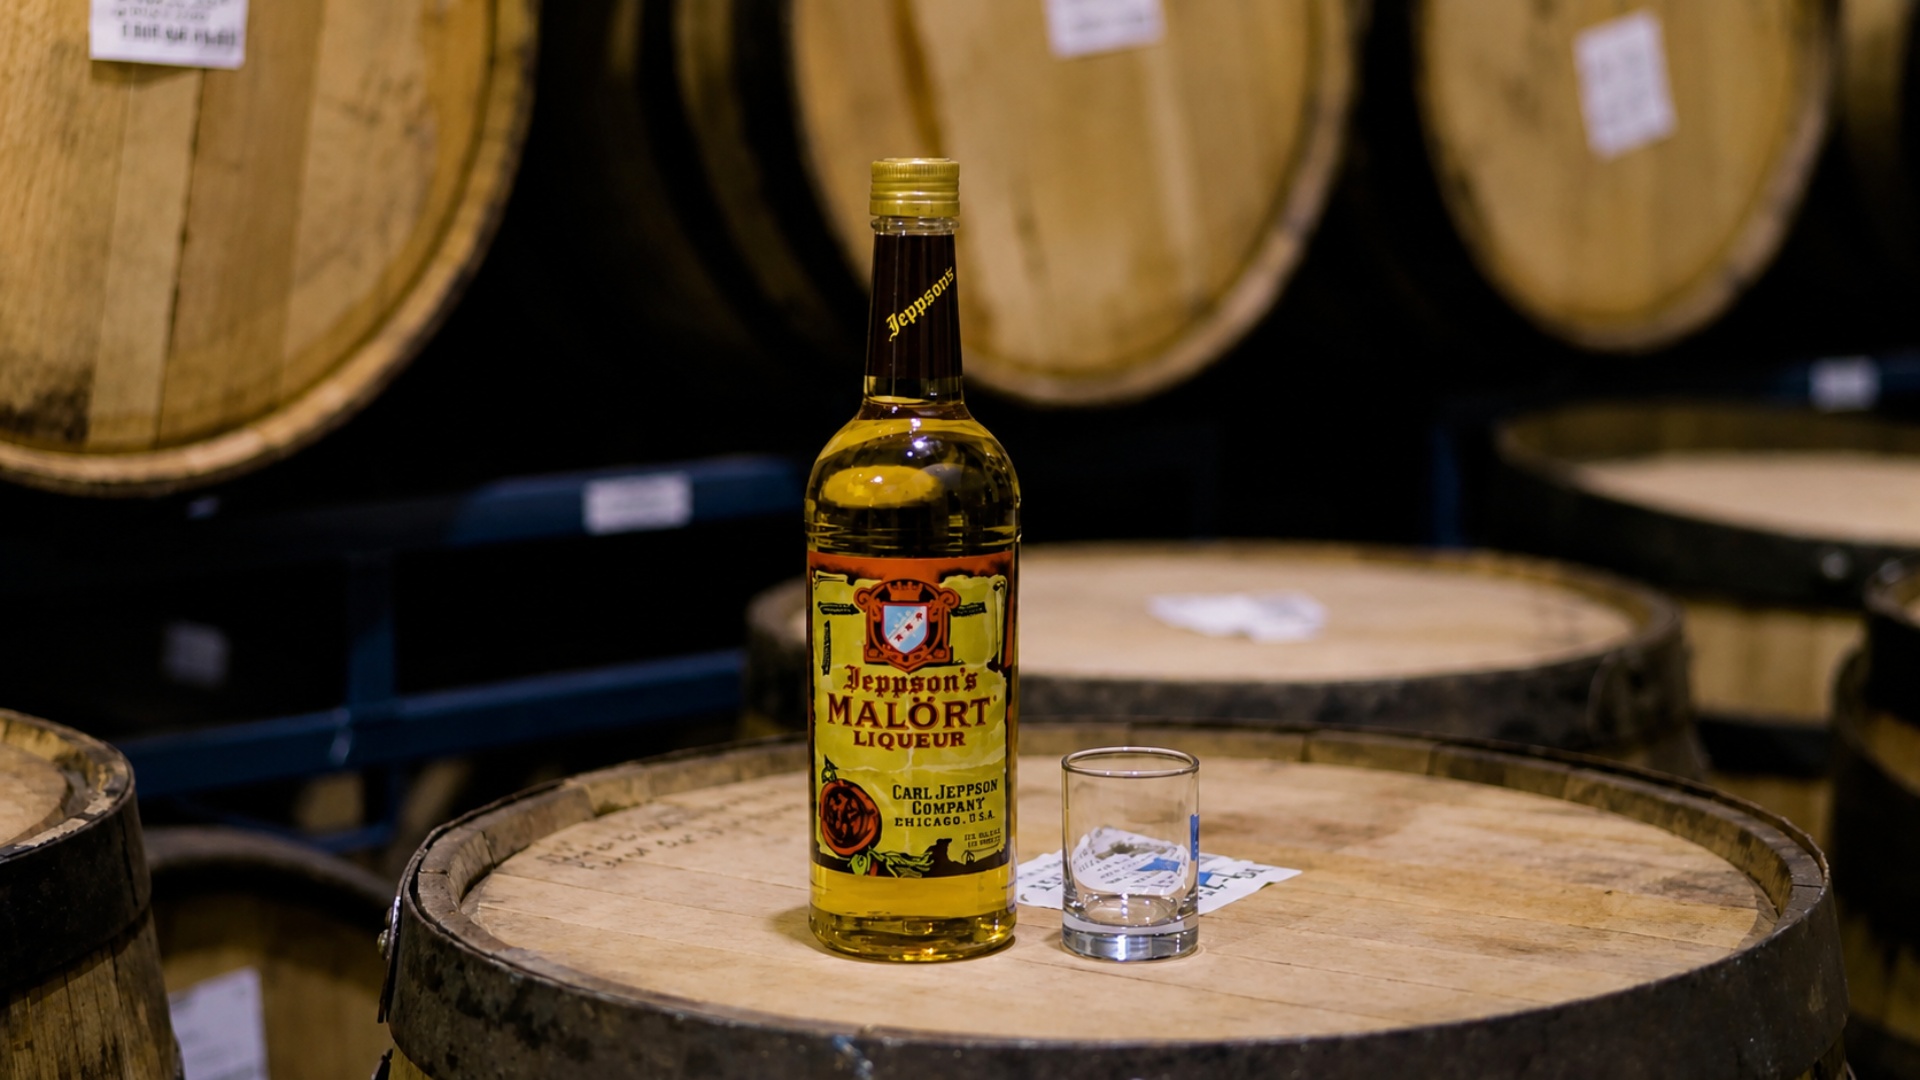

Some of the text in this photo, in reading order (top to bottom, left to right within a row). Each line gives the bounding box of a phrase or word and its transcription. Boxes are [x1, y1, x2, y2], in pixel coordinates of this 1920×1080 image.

[843, 665, 978, 698] Jeppson's
[853, 730, 967, 750] LIQUEUR
[892, 778, 999, 800] CARL JEPPSON
[912, 796, 985, 816] COMPANY
